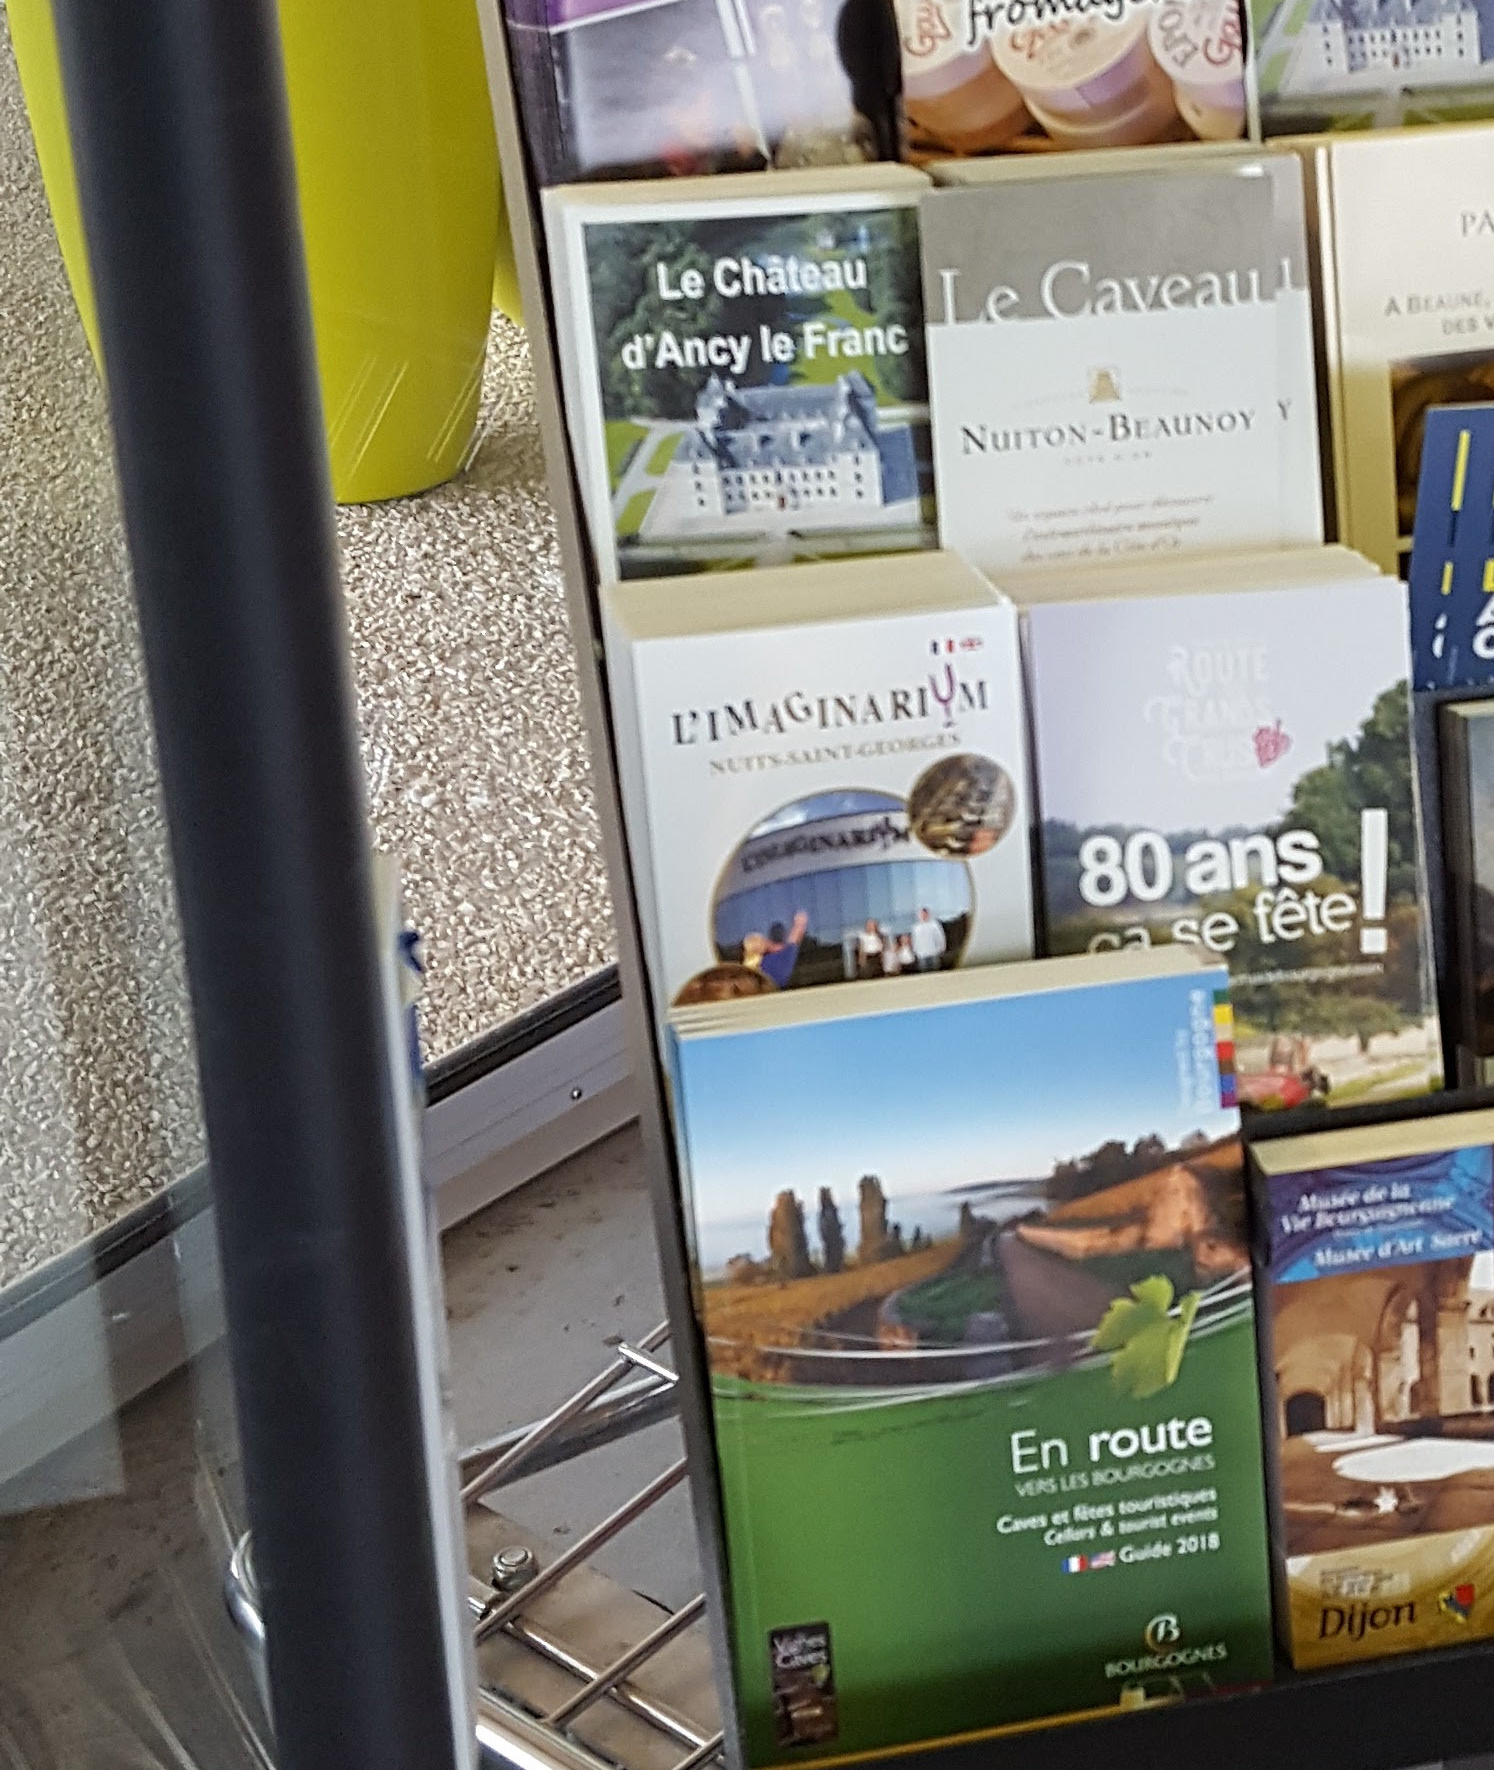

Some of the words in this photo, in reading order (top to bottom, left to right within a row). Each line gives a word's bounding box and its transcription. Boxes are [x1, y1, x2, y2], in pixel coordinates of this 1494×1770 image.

[656, 262, 705, 300] Le
[713, 253, 867, 298] Château
[938, 267, 1020, 326] Le
[1040, 258, 1259, 320] Caveau
[1384, 296, 1401, 316] A
[1442, 315, 1479, 335] DES
[621, 331, 752, 374] d'Ancy
[760, 326, 797, 364] le
[803, 320, 910, 360] Franc
[960, 409, 1257, 455] NUITON-BEAUNOY
[671, 663, 990, 746] L'IMAGINARIUM
[709, 732, 961, 776] NUITS-SAINT-GEORGES
[1078, 830, 1173, 907] 80
[1184, 829, 1323, 895] ans
[1171, 911, 1239, 952] se
[1252, 887, 1357, 944] fête
[1298, 1189, 1359, 1213] Musée
[1364, 1186, 1386, 1204] de
[1391, 1182, 1411, 1199] la
[1281, 1214, 1312, 1233] Vie
[1313, 1245, 1375, 1268] Musée
[1378, 1233, 1424, 1259] d'Art
[1431, 1229, 1482, 1253] Sacré
[1010, 1429, 1069, 1474] En
[1089, 1416, 1213, 1462] route
[1015, 1476, 1058, 1497] VERS
[1060, 1472, 1089, 1492] LES
[1092, 1454, 1216, 1486] BOURGOGNES
[997, 1513, 1048, 1534] Caves
[1052, 1511, 1070, 1526] et
[1118, 1487, 1217, 1514] touristiques
[1044, 1525, 1096, 1546] Cellars
[1100, 1520, 1115, 1538] &
[1118, 1513, 1167, 1534] tourist
[1118, 1540, 1173, 1563] Guide
[1177, 1532, 1221, 1555] 2018
[1318, 1599, 1416, 1641] Dijon
[1104, 1641, 1228, 1678] BOURGOGNES
